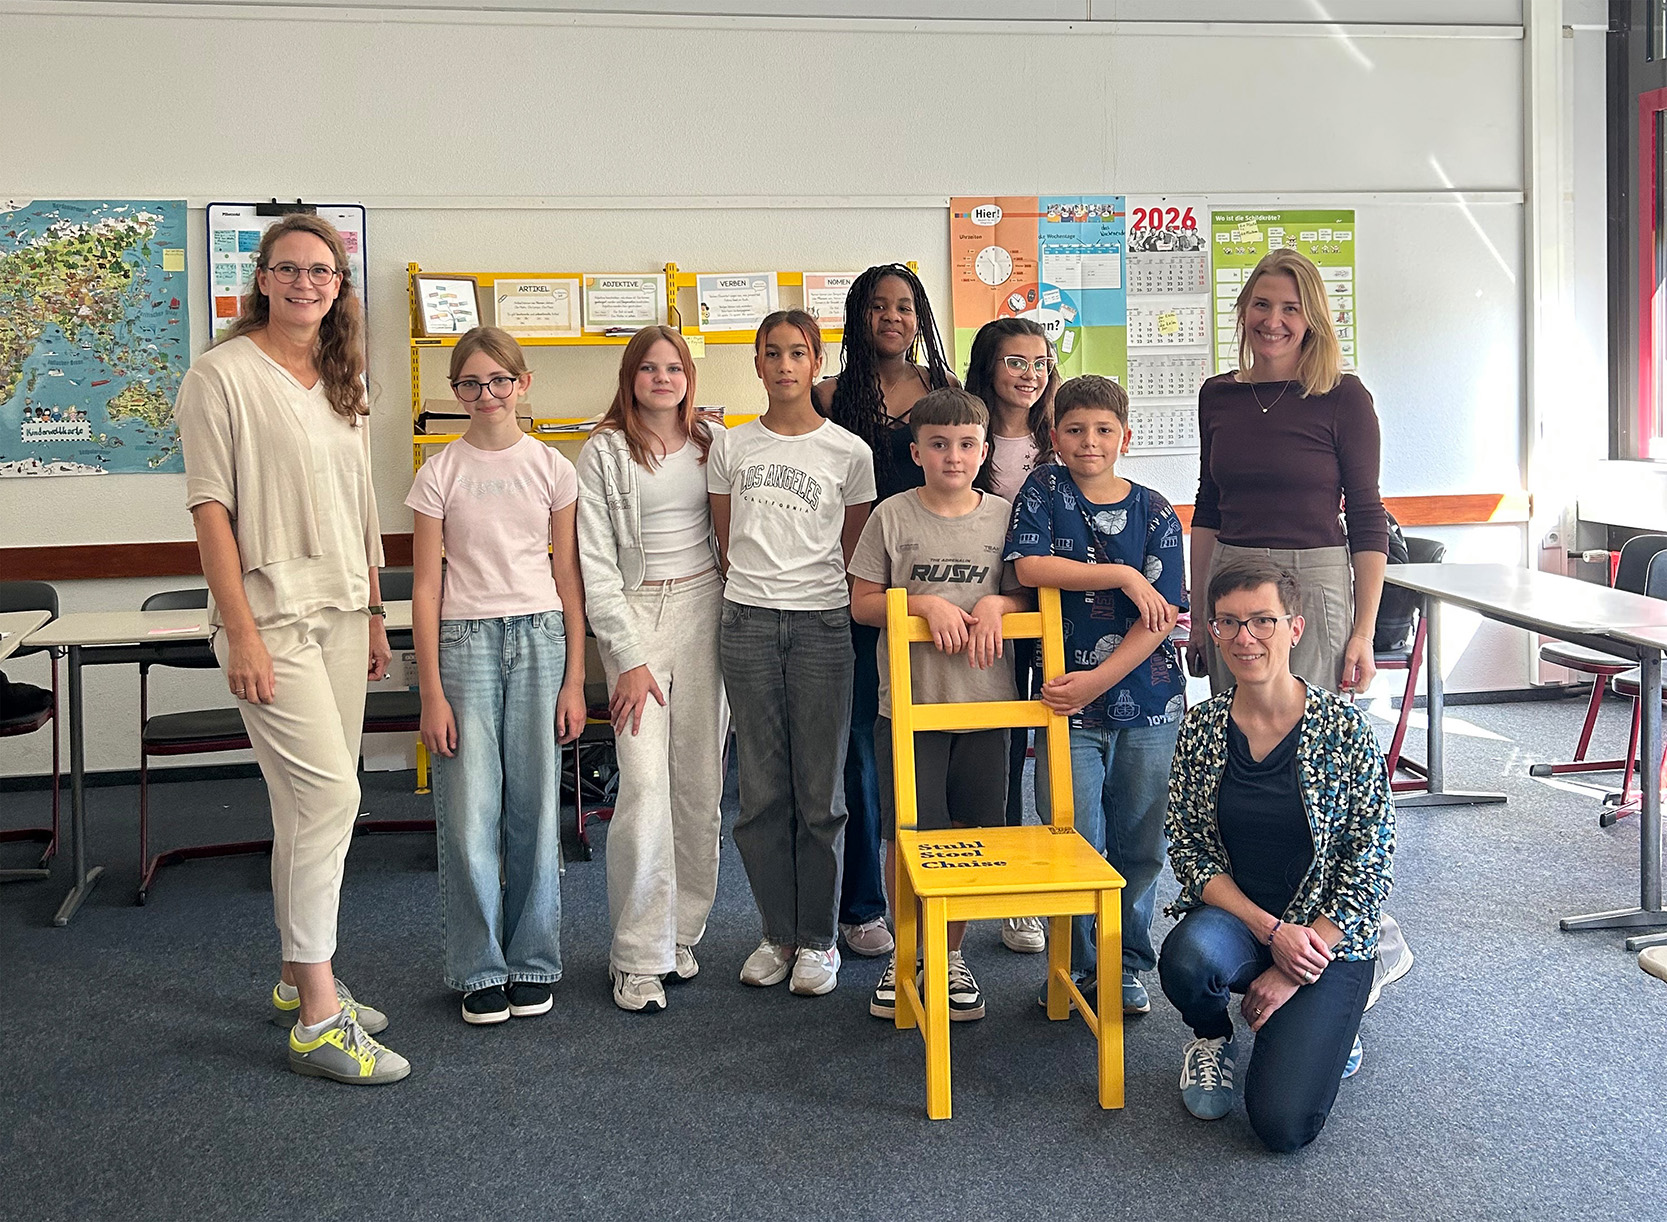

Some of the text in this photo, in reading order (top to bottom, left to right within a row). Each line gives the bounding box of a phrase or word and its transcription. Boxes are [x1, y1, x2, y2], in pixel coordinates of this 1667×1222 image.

[976, 209, 999, 218] Hier!
[1132, 207, 1196, 231] 2026
[26, 426, 83, 436] Kinderweltkarte
[740, 464, 822, 511] LOS ANGELES
[744, 496, 809, 513] CALIFORNIA
[910, 564, 990, 583] RUSH
[918, 841, 985, 851] Stuhl
[920, 850, 984, 859] Stoel
[921, 861, 1007, 869] Chaise
